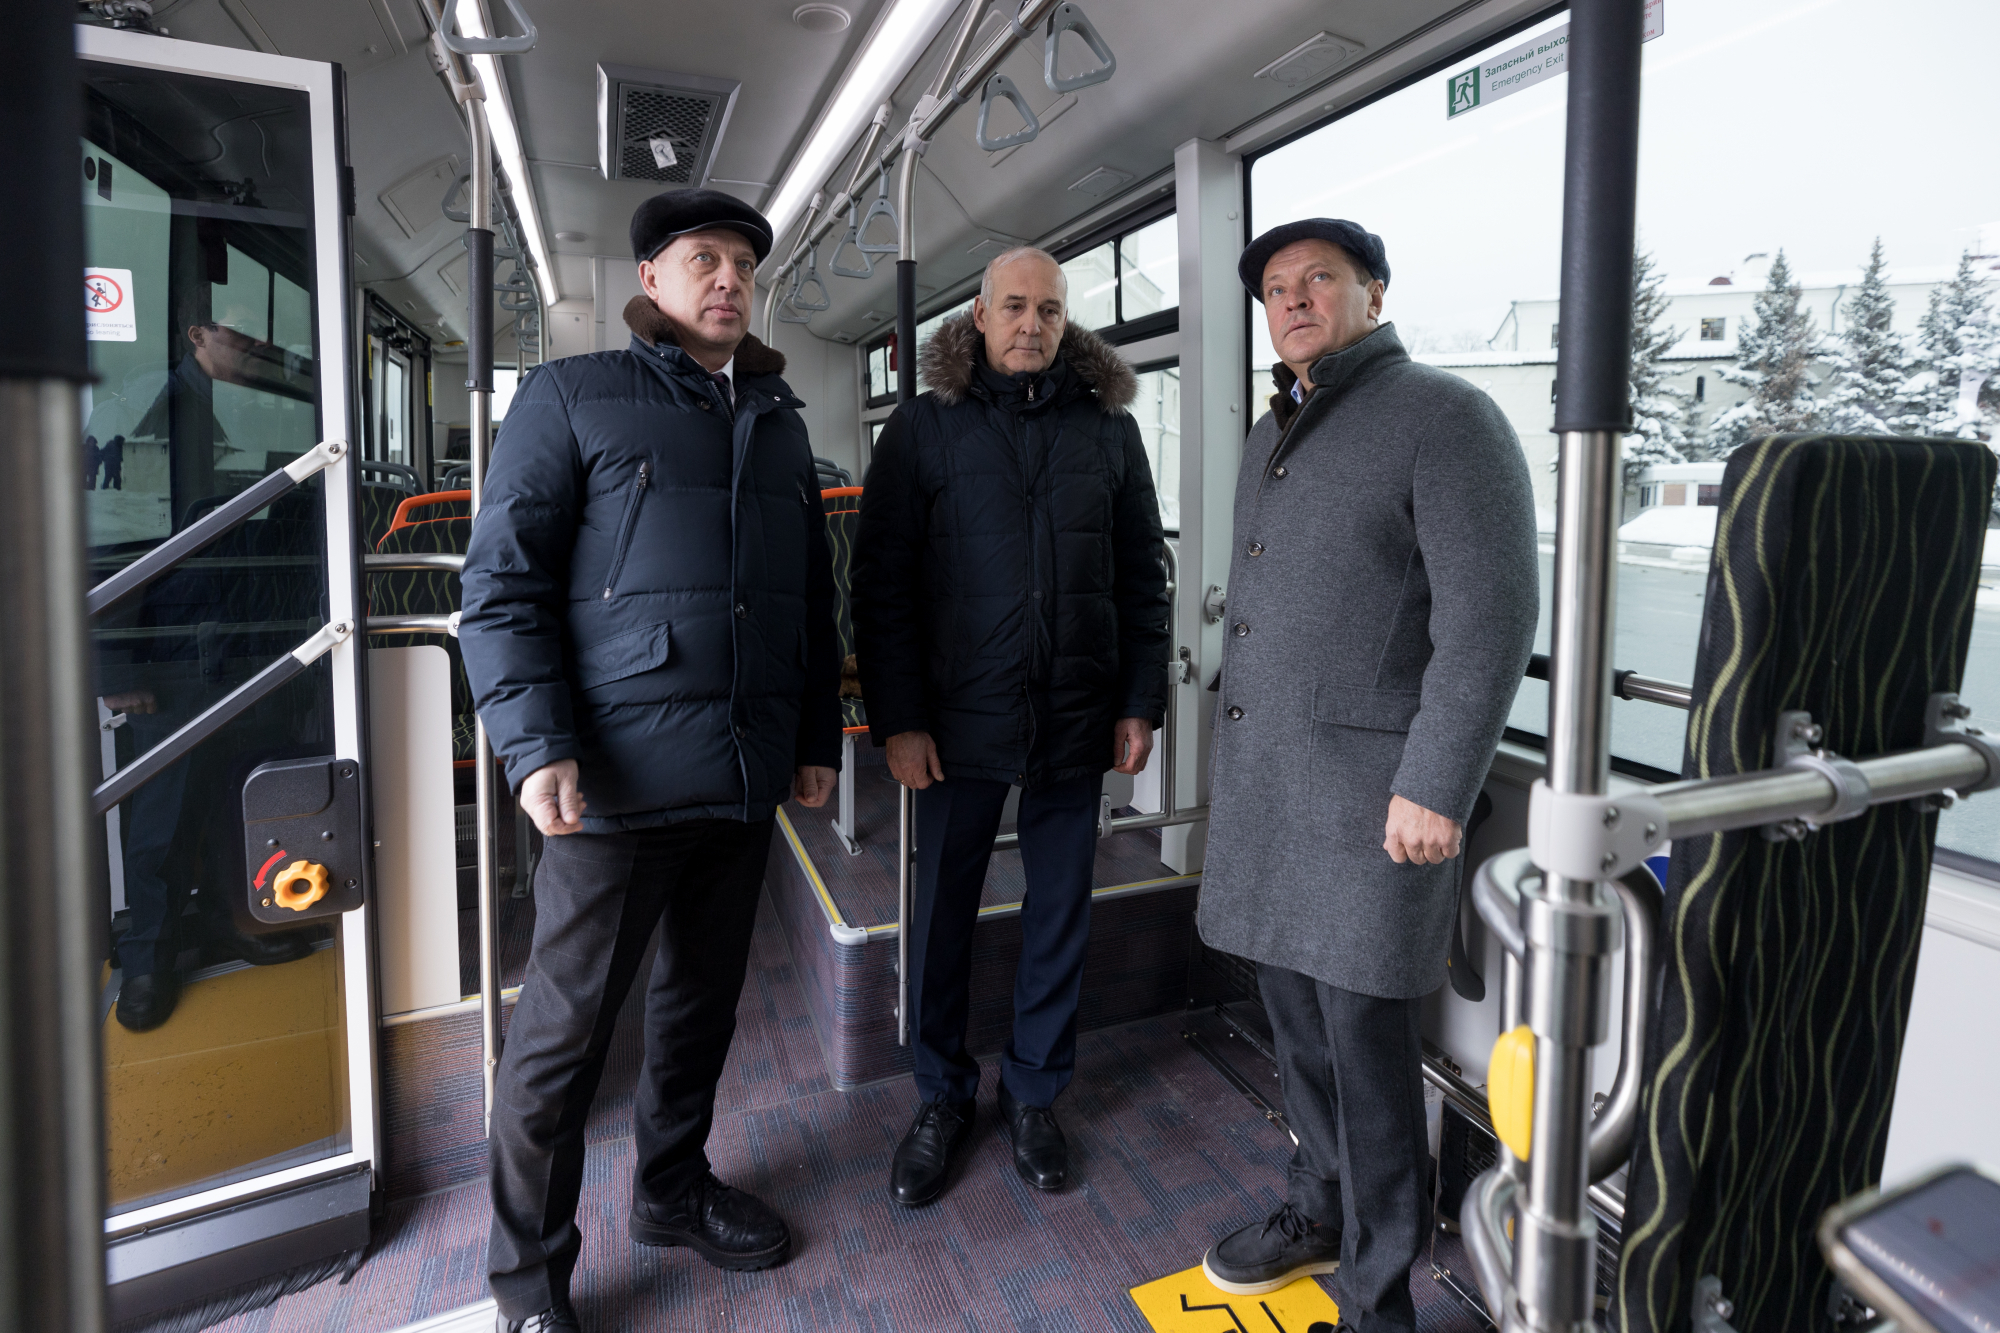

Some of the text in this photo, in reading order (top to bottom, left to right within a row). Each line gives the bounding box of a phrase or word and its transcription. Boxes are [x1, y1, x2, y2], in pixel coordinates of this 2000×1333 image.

[1485, 48, 1534, 78] Запасный
[1492, 52, 1565, 91] Emergency Exit
